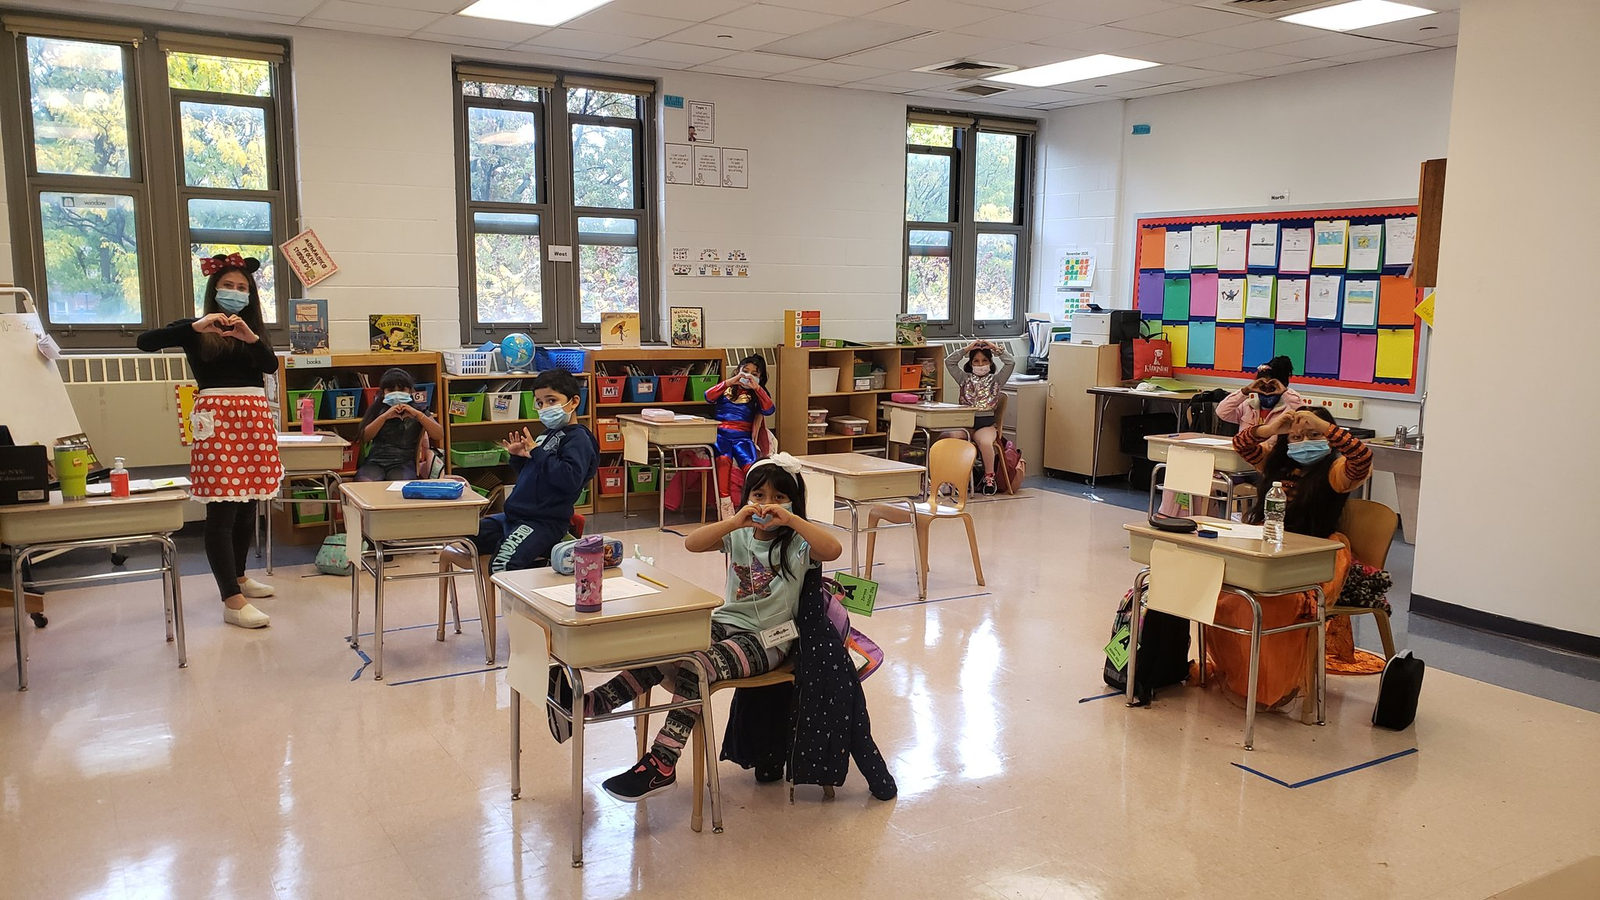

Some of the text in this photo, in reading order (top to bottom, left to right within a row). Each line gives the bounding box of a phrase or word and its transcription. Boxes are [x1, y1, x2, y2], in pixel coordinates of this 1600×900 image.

[306, 357, 321, 365] books
[341, 399, 346, 407] C
[341, 409, 346, 417] D
